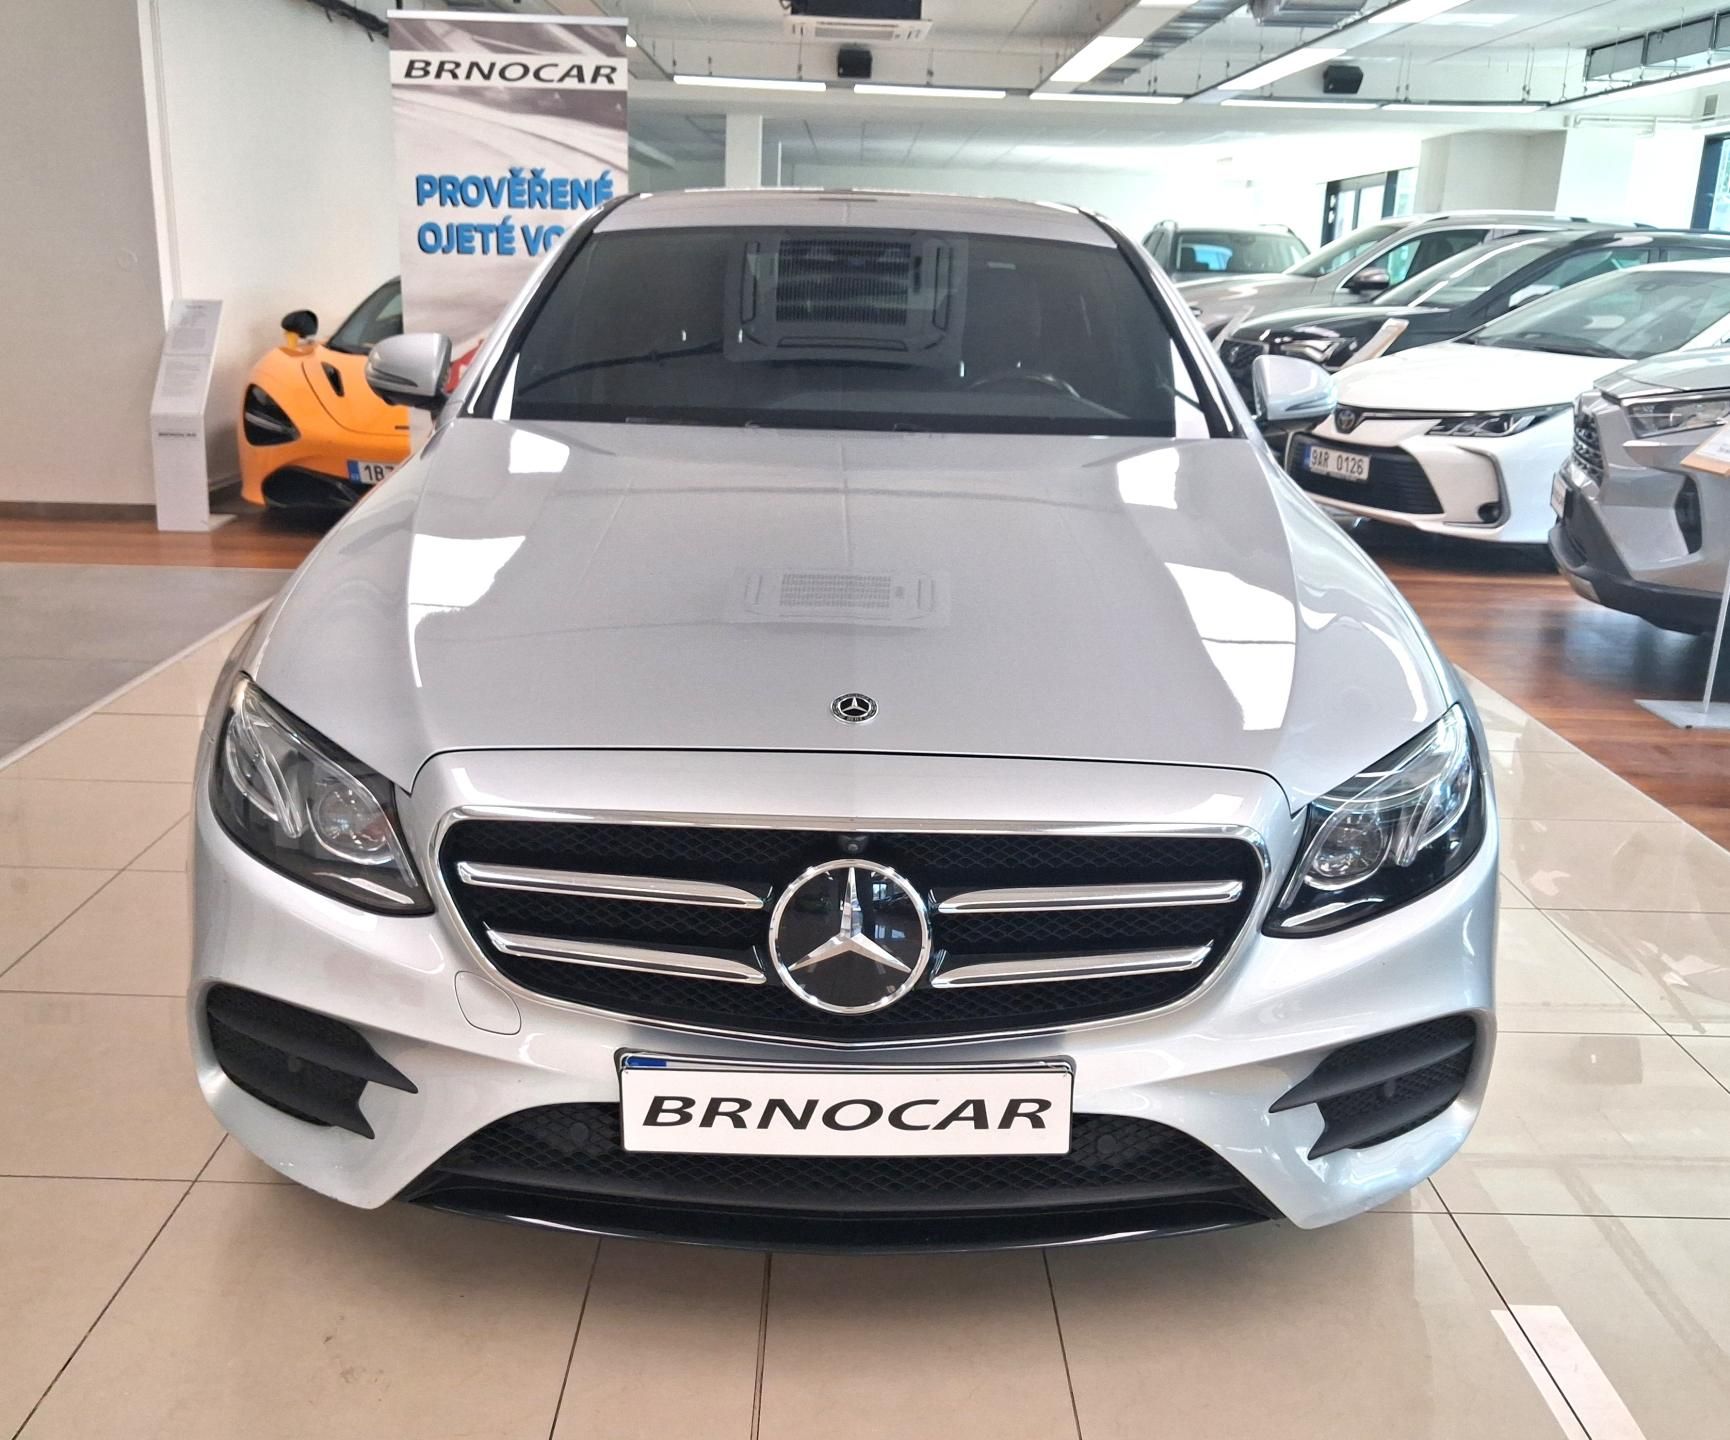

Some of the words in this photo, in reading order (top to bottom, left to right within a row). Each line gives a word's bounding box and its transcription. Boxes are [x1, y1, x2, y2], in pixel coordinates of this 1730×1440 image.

[403, 58, 618, 85] BRNOCAR
[415, 166, 614, 210] PROVĚŘENÉ
[417, 215, 516, 256] OJETÉ
[1312, 449, 1329, 468] 9AR
[1336, 454, 1364, 475] 0126
[642, 1095, 1053, 1132] BRNOCAR
